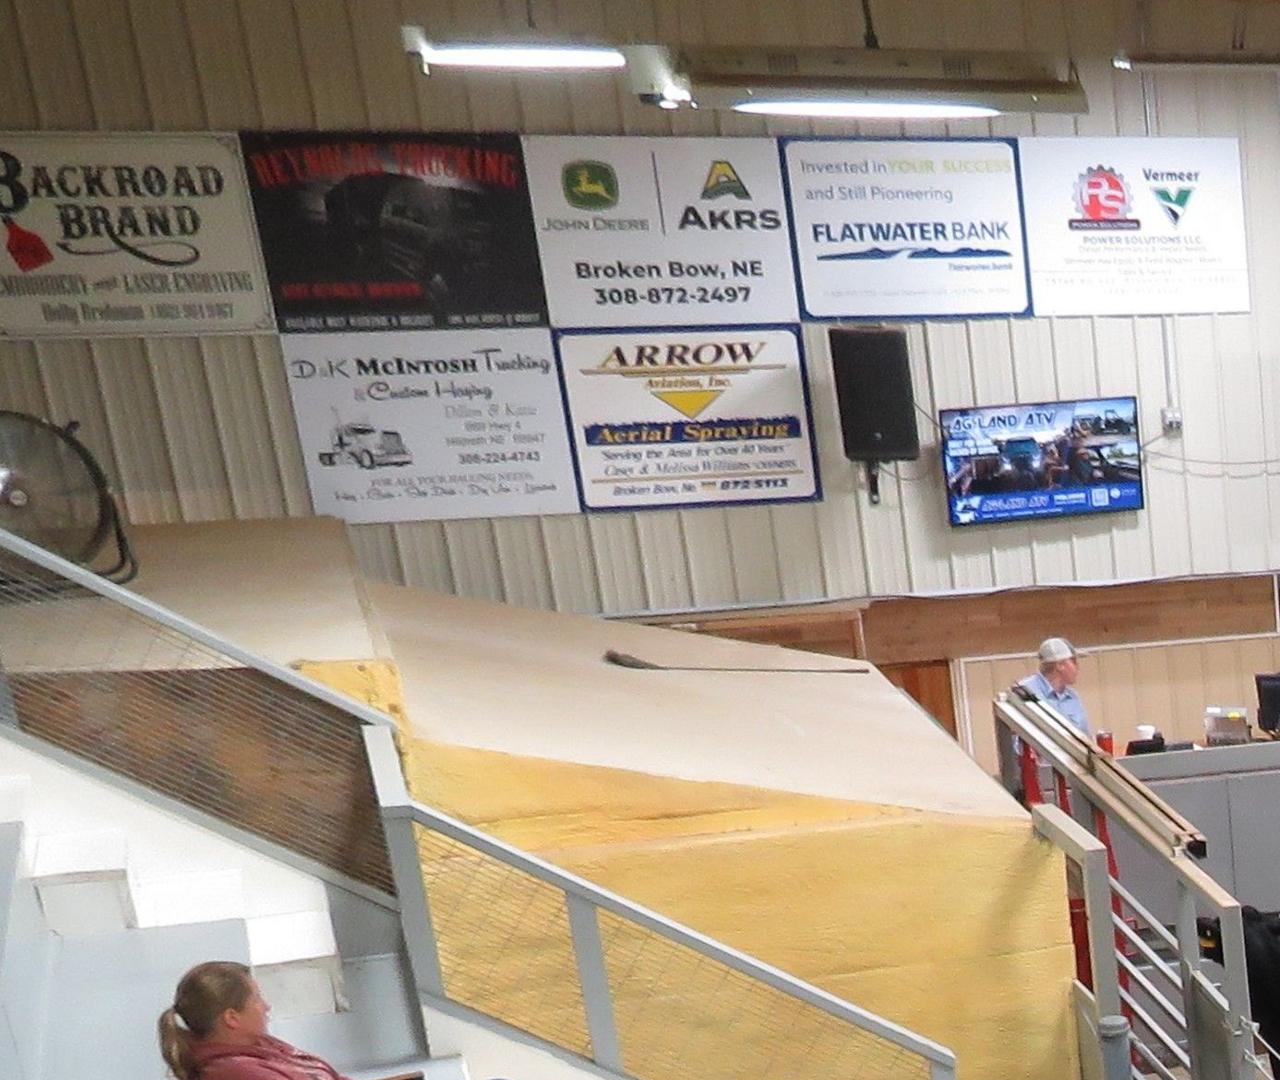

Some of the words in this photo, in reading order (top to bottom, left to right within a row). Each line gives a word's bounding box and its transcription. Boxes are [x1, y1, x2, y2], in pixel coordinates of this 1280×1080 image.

[800, 160, 869, 175] Invested
[888, 159, 936, 174] YOUR
[943, 159, 1012, 174] SUCCESS
[1142, 168, 1200, 183] Vermeer
[805, 186, 834, 201] and
[838, 186, 867, 201] Still
[870, 186, 954, 204] Pioneering
[55, 203, 201, 241] BRAND
[541, 217, 591, 231] JOHN
[592, 216, 650, 231] DEERE
[677, 205, 782, 231] AKRS
[811, 222, 949, 243] FLATWATER
[951, 221, 1012, 241] BANK
[574, 260, 662, 280] Broken
[668, 260, 727, 280] Bow,
[731, 260, 765, 277] NE
[594, 286, 752, 306] 308-872-2497
[473, 348, 550, 375] Trucking
[600, 341, 768, 368] ARROW
[366, 381, 429, 401] Custom
[434, 380, 493, 402] Haying
[1024, 410, 1056, 426] ATV
[597, 425, 673, 444] Aerial
[683, 421, 791, 442] Spraying
[602, 450, 643, 461] Serving
